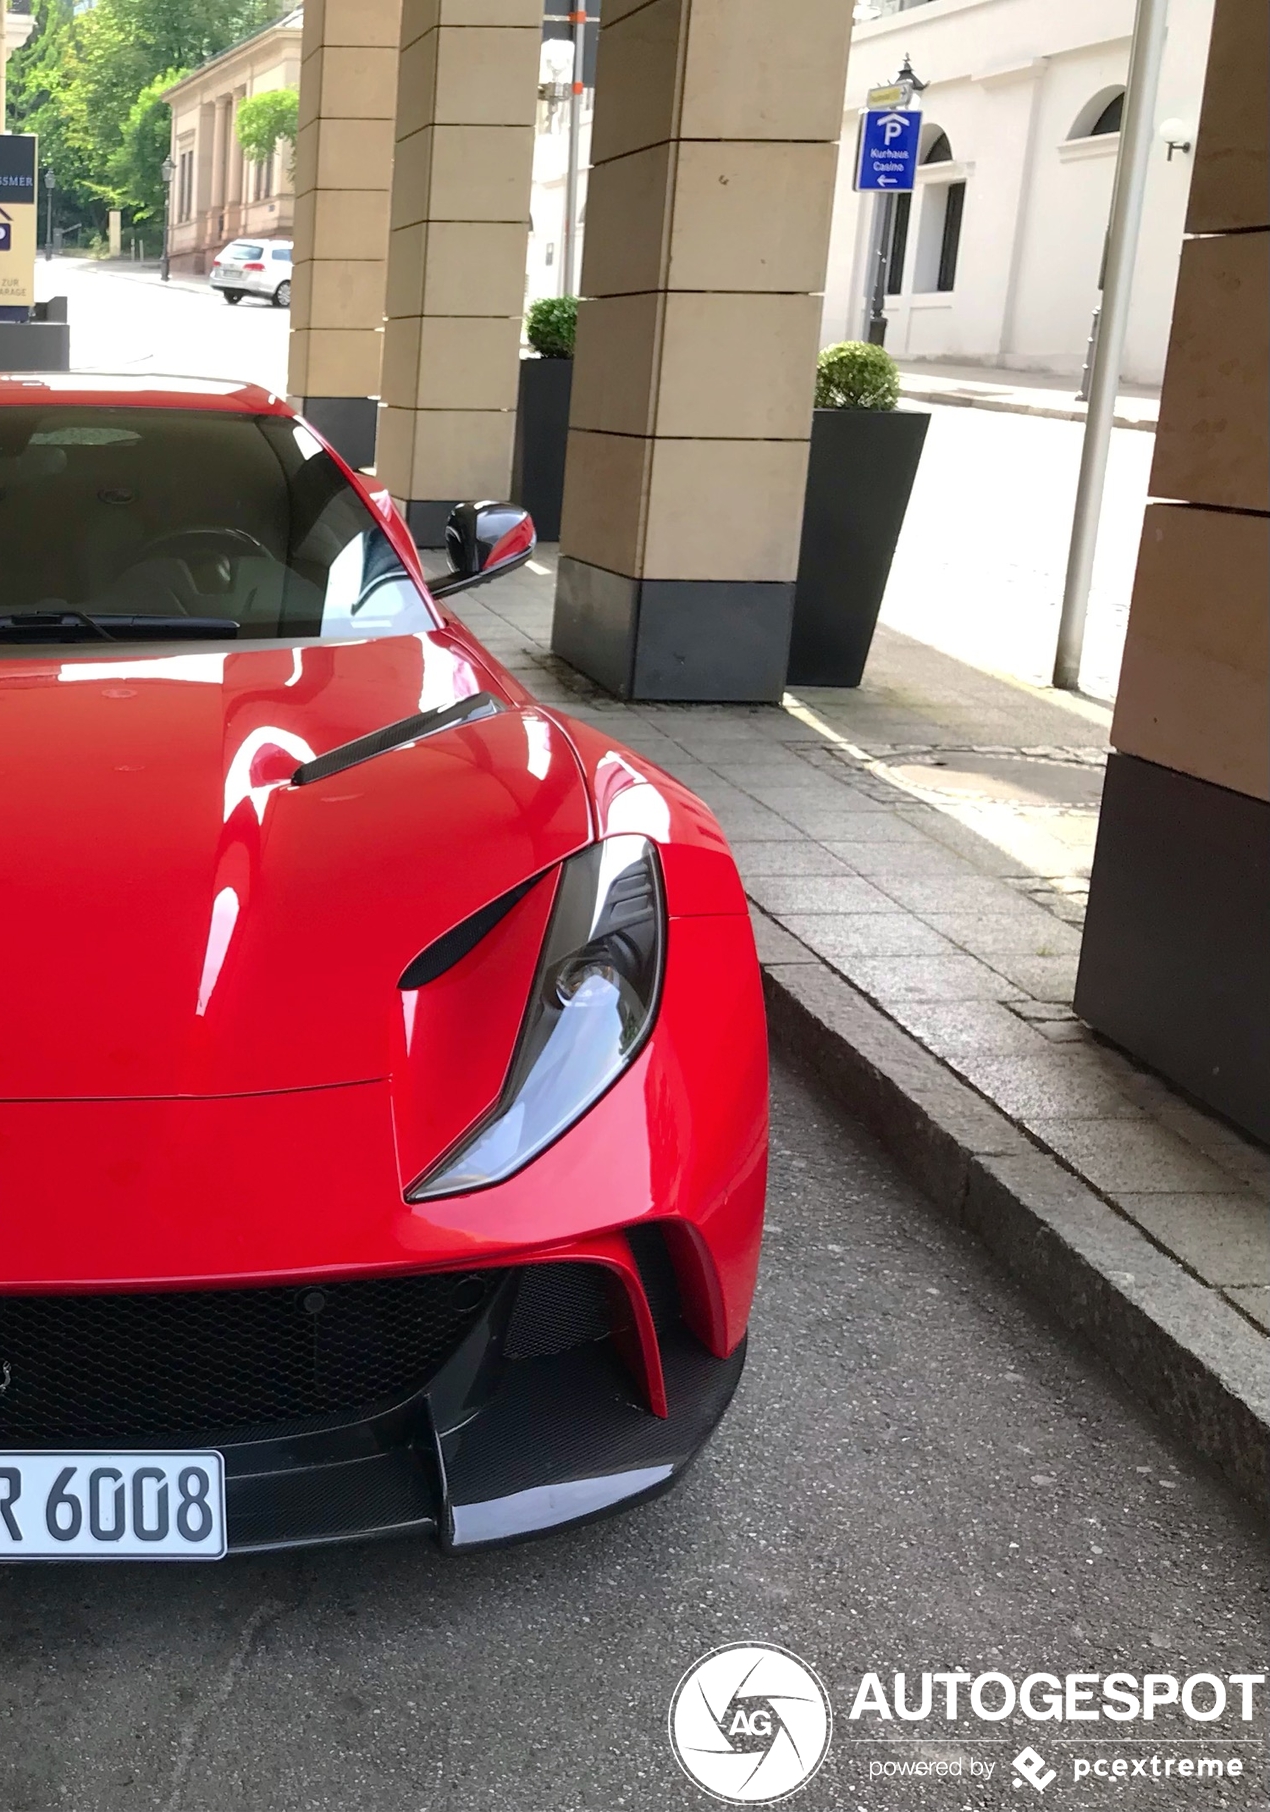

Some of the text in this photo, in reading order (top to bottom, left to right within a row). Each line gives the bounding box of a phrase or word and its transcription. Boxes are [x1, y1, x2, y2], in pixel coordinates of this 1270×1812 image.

[884, 123, 902, 145] P
[870, 148, 909, 158] Kurhaus
[873, 161, 904, 172] Casino
[45, 1465, 214, 1543] 6008
